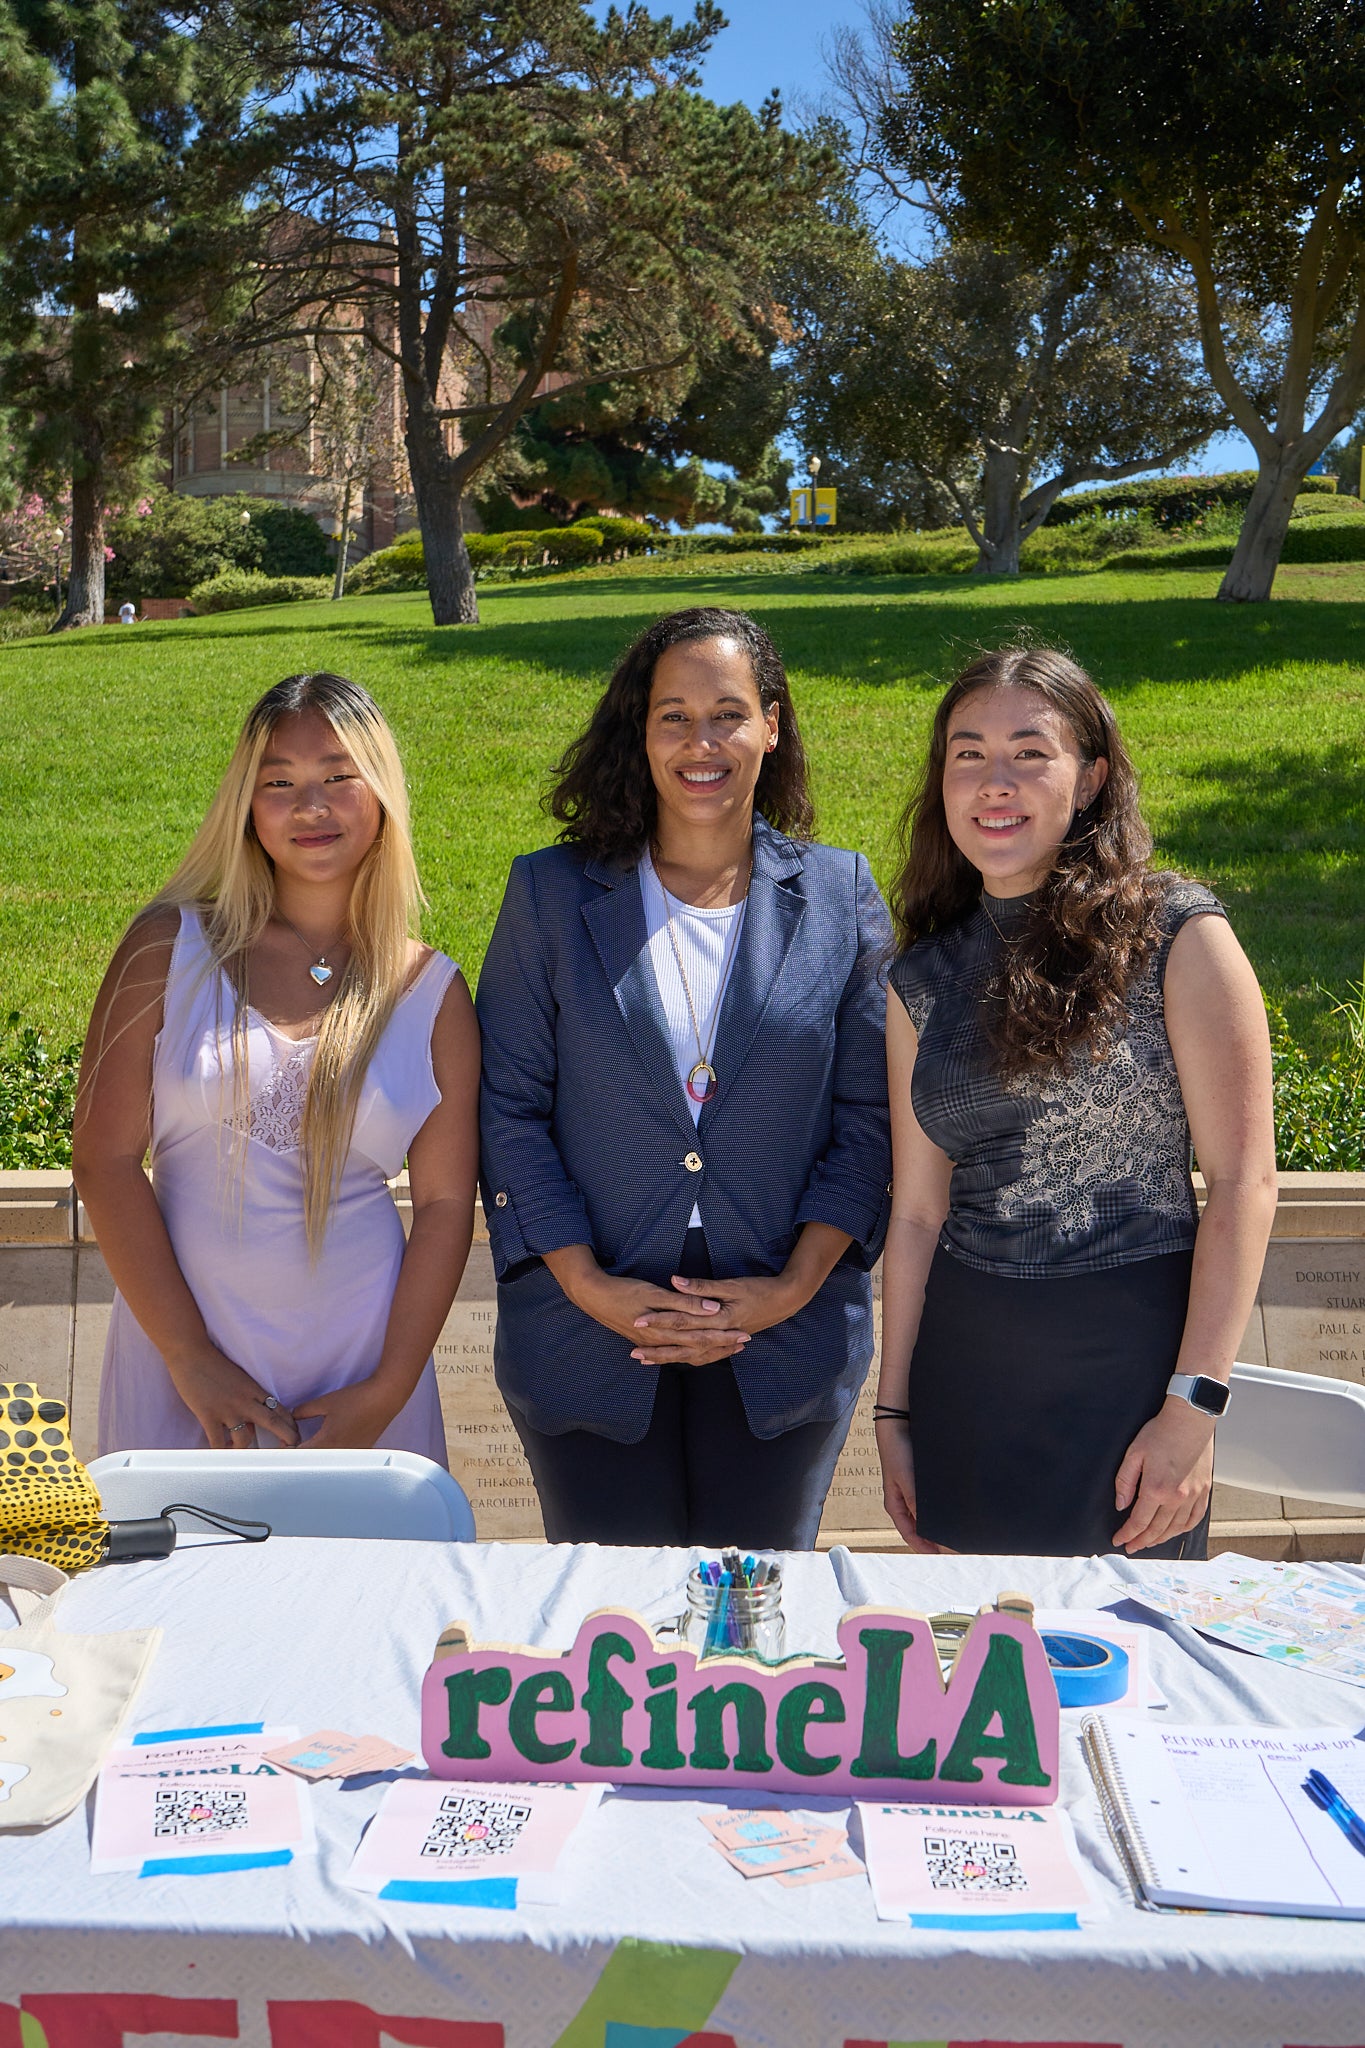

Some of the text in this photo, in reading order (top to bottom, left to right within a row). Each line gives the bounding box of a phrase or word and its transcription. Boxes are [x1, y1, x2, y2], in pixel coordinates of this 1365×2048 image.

[1295, 1271, 1361, 1283] DOROTHY
[1327, 1297, 1365, 1309] STUAR
[470, 1311, 492, 1321] THE
[1320, 1323, 1362, 1334] PAUL &
[437, 1345, 458, 1354] THE
[1320, 1349, 1358, 1361] NORA
[434, 1365, 480, 1374] ZZANNE
[456, 1424, 487, 1434] THEO
[849, 1428, 876, 1437] ORGE
[487, 1444, 525, 1453] THE SU
[853, 1447, 879, 1456] FOUN
[507, 1457, 529, 1467] CAN
[868, 1467, 881, 1476] KE
[476, 1477, 533, 1488] THE KORE
[441, 1630, 1052, 1788] refineLA
[1220, 1738, 1239, 1749] LA
[1242, 1739, 1288, 1751] EMAIL
[146, 1744, 248, 1760] Refine LA
